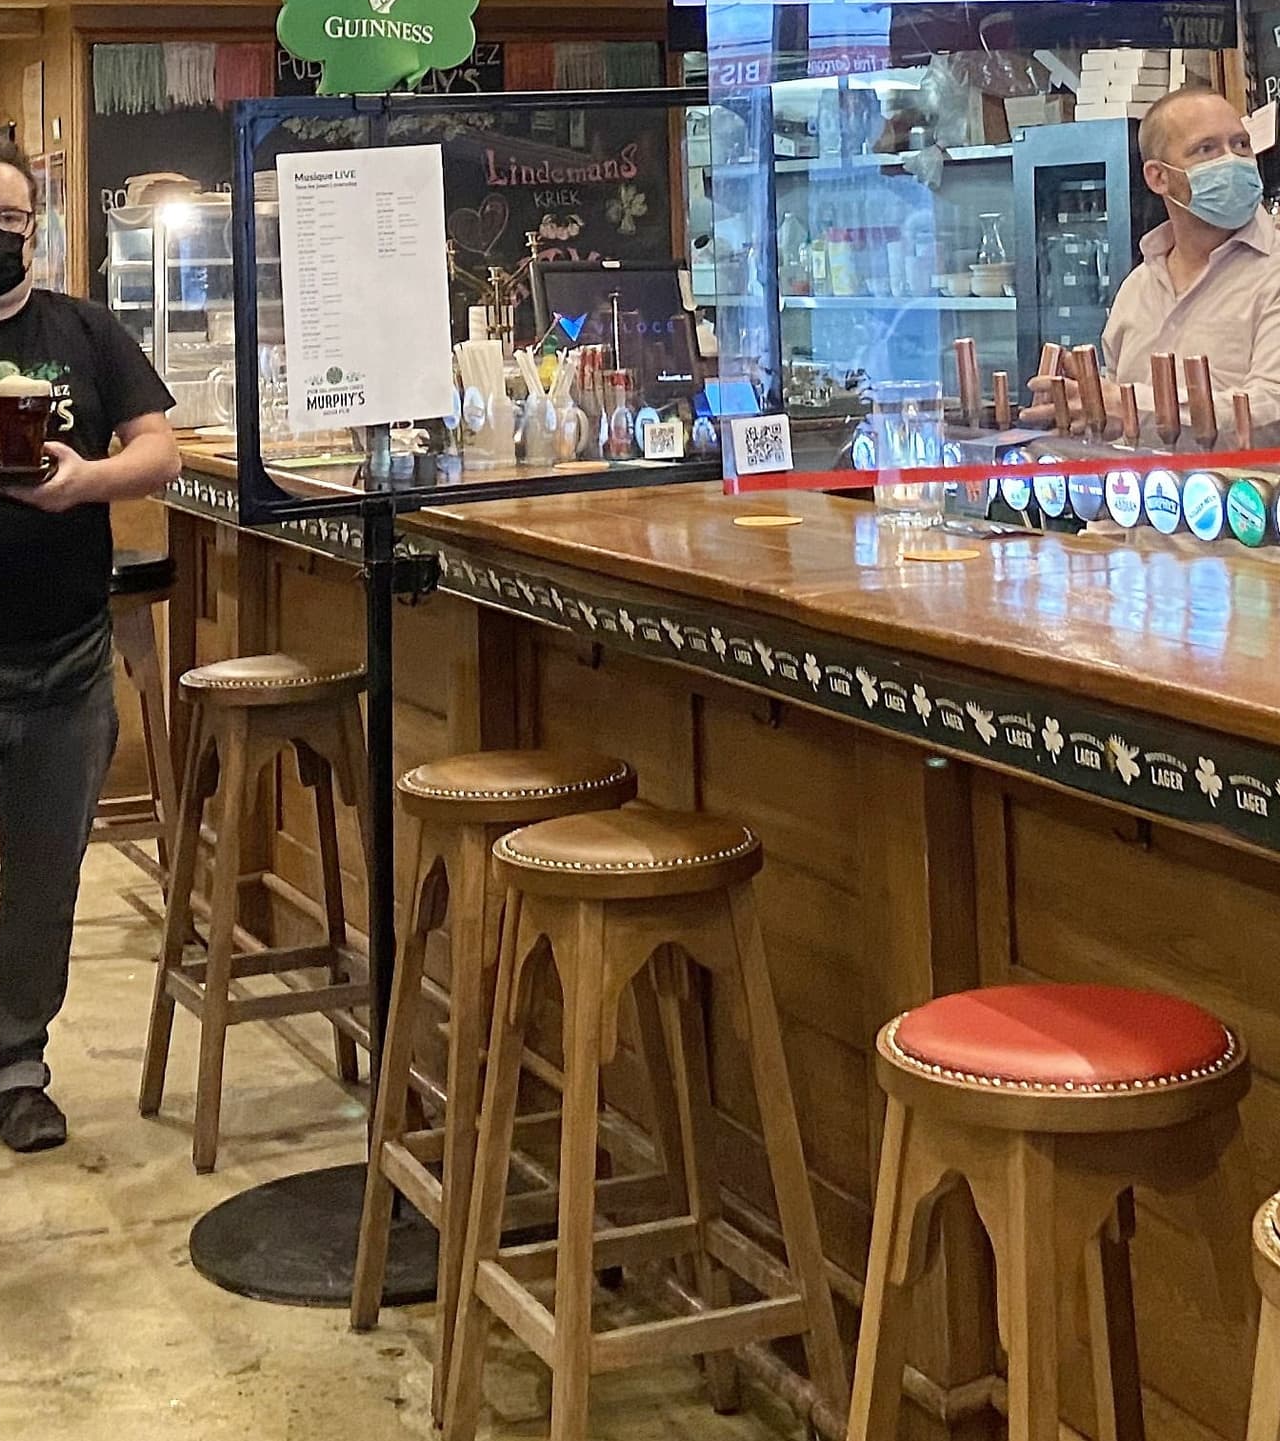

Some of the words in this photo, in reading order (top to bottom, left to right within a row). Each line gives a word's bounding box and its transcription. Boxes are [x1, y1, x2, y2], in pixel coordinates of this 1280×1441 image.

[323, 14, 434, 46] GUINNESS
[294, 171, 333, 187] Musique
[532, 189, 583, 209] KRIEK
[593, 319, 676, 335] VLOCE
[306, 390, 367, 412] MURPHY'S
[829, 675, 851, 697] LAGER
[883, 692, 907, 714] LAGER
[941, 710, 965, 732] LAGER
[1005, 727, 1033, 750] LAGER
[1074, 745, 1102, 771] LAGER
[1150, 765, 1185, 792] LAGER
[1235, 787, 1269, 818] LAGER
